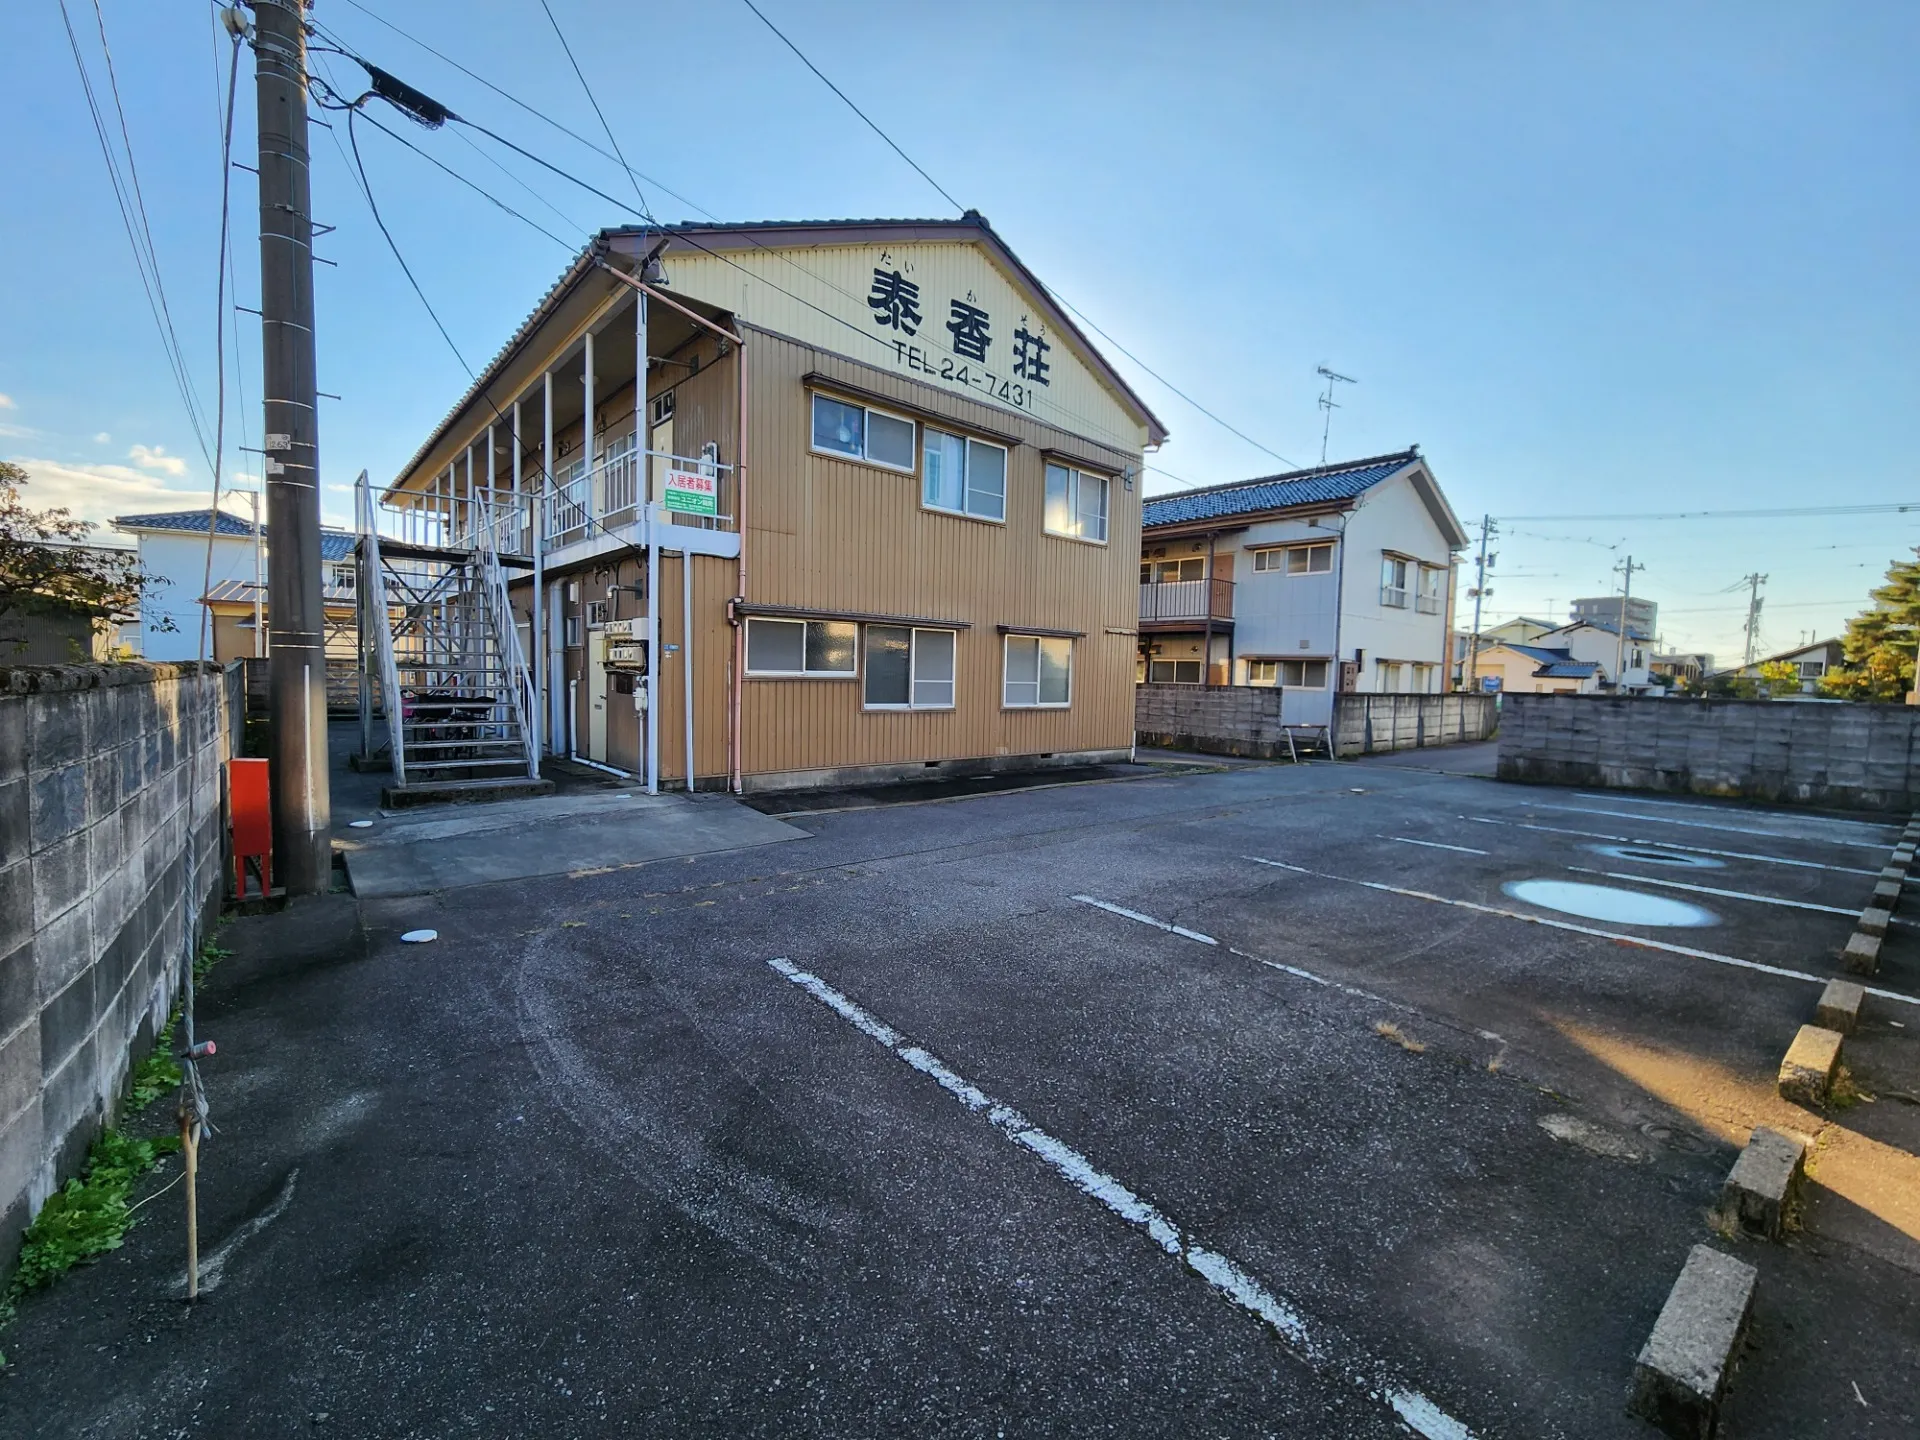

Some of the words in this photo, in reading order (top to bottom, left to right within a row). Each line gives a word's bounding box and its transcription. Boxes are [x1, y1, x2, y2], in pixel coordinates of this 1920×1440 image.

[880, 250, 914, 273] たい
[966, 289, 977, 303] か
[867, 267, 1050, 387] 泰香荘
[892, 339, 936, 375] TEL
[940, 357, 1032, 409] 24-7431
[668, 473, 712, 492] 入居者募集
